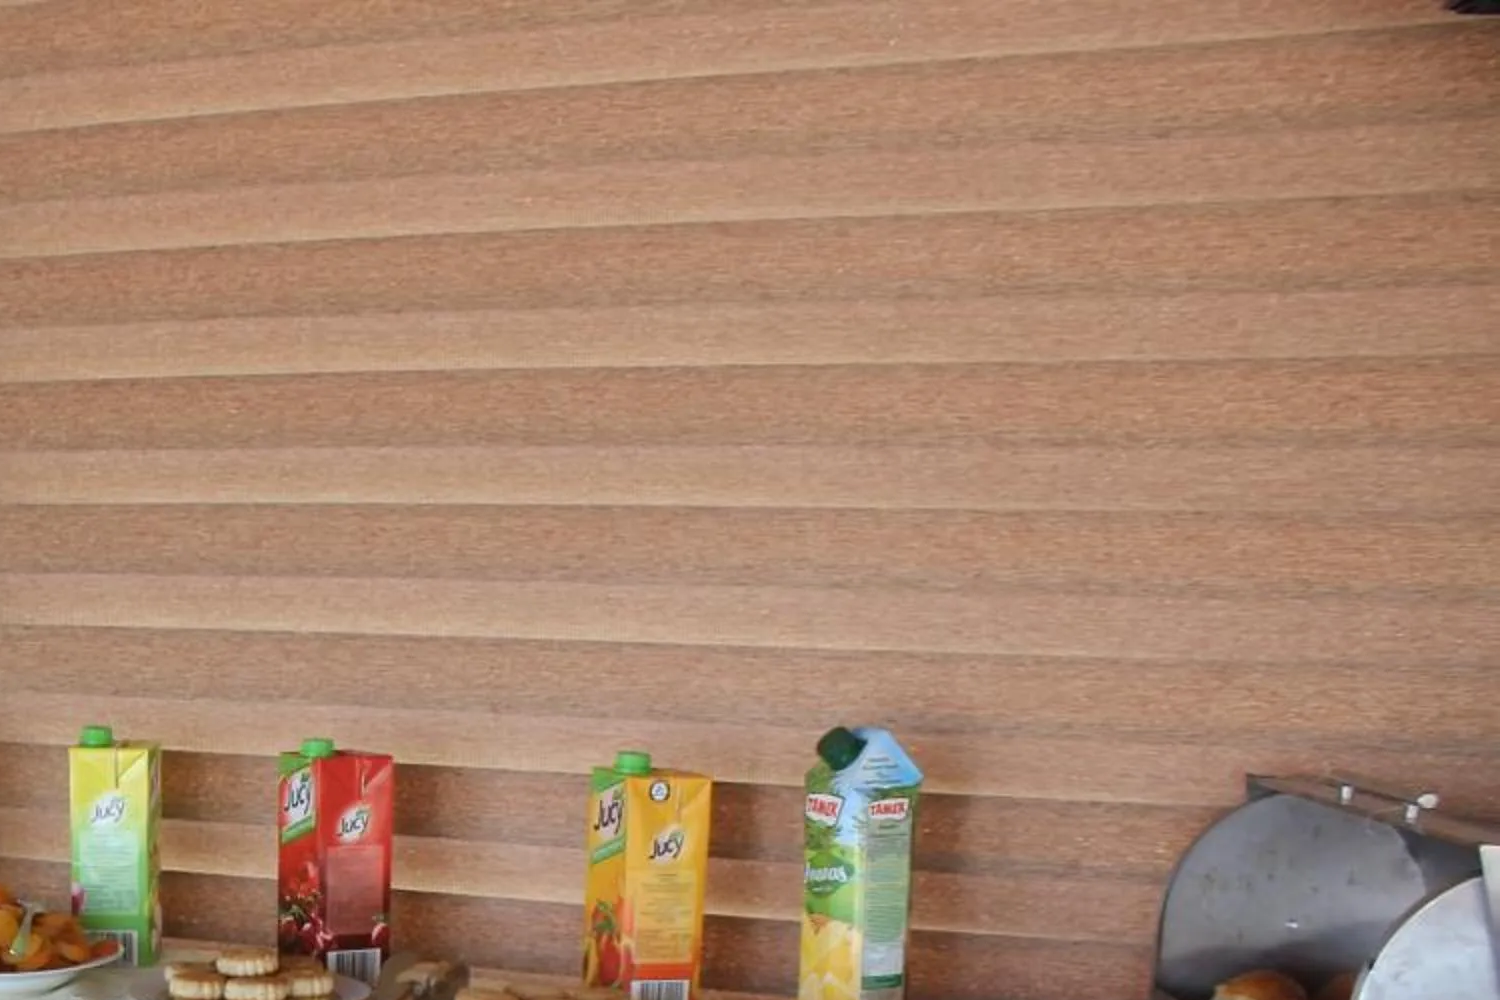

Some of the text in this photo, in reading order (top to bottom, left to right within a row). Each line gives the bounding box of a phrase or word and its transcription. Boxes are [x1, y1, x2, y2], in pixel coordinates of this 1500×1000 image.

[89, 796, 126, 823] Jucy
[284, 779, 311, 815] Jucy
[336, 812, 369, 837] Jucy
[593, 799, 624, 834] Jucy
[647, 833, 685, 859] Jucy
